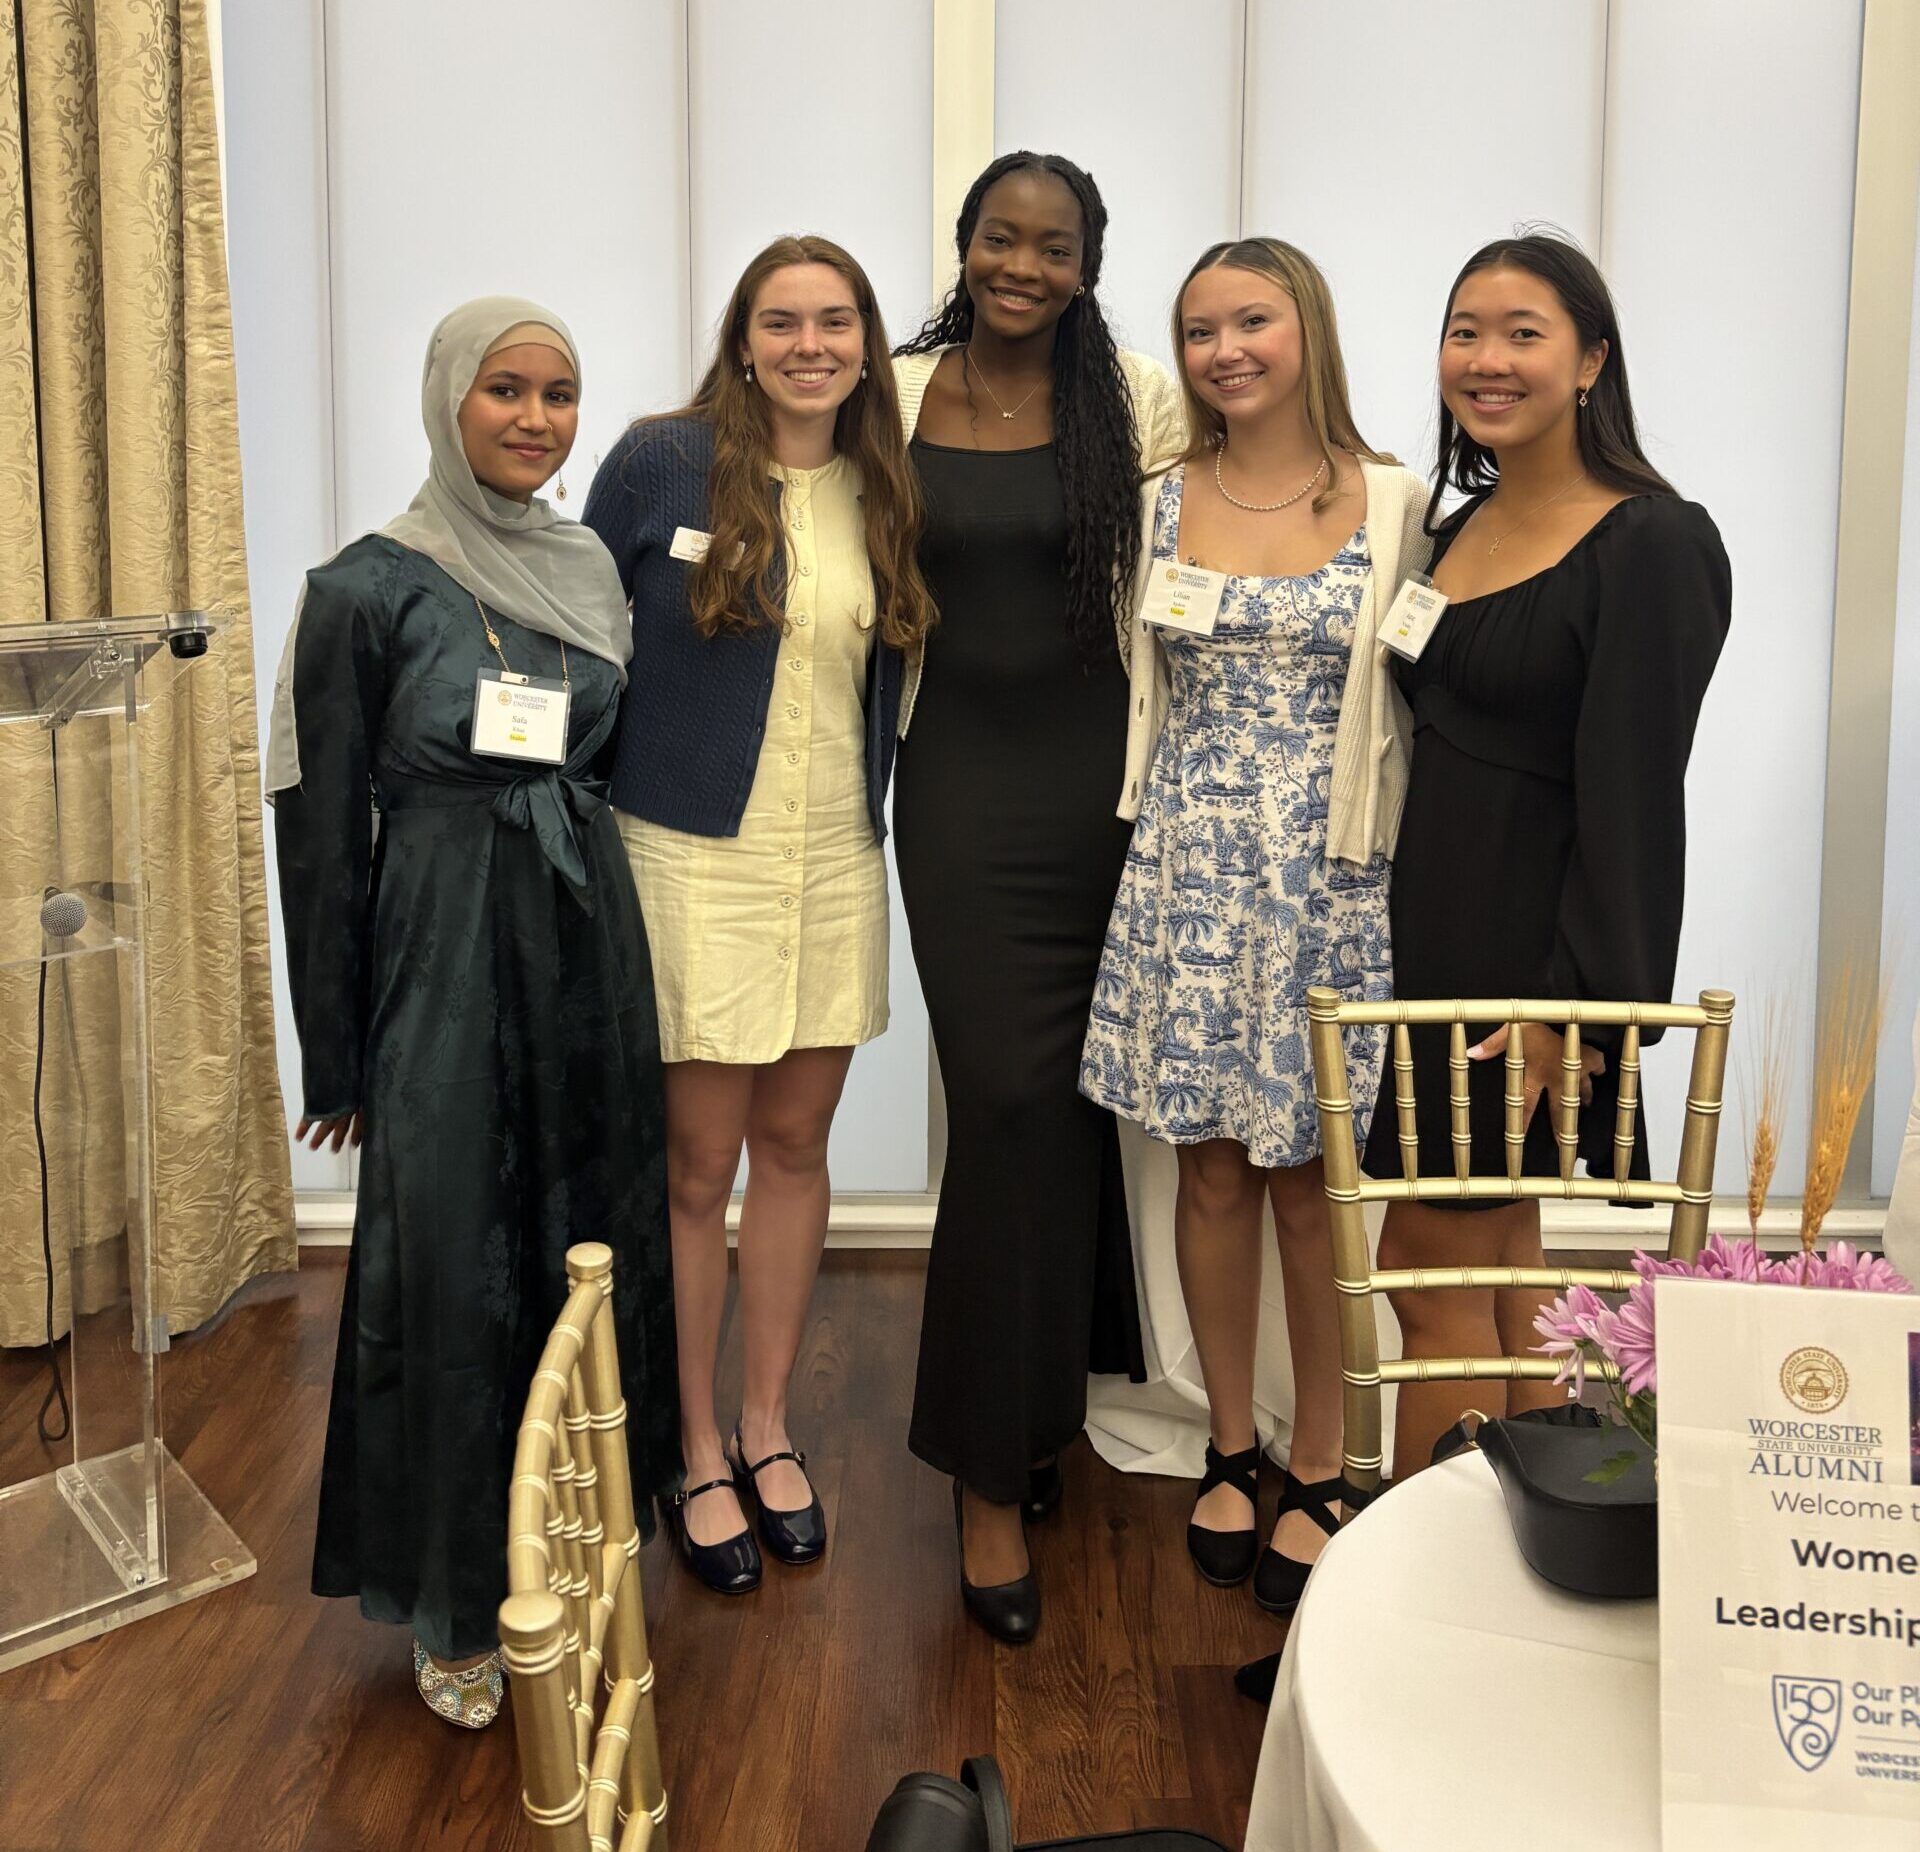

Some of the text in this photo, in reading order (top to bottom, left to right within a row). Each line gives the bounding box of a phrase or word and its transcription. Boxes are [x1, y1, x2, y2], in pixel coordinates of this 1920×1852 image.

[1748, 1419, 1883, 1444] WORCESTER
[1757, 1439, 1874, 1456] STATE UNIVERSITY
[1750, 1452, 1884, 1483] ALUMNI
[1771, 1490, 1903, 1520] Welcome
[1791, 1538, 1919, 1575] Wome
[1716, 1597, 1920, 1648] Leadership
[1779, 1682, 1836, 1722] 150
[1852, 1681, 1894, 1702] Our
[1852, 1705, 1894, 1725] Our
